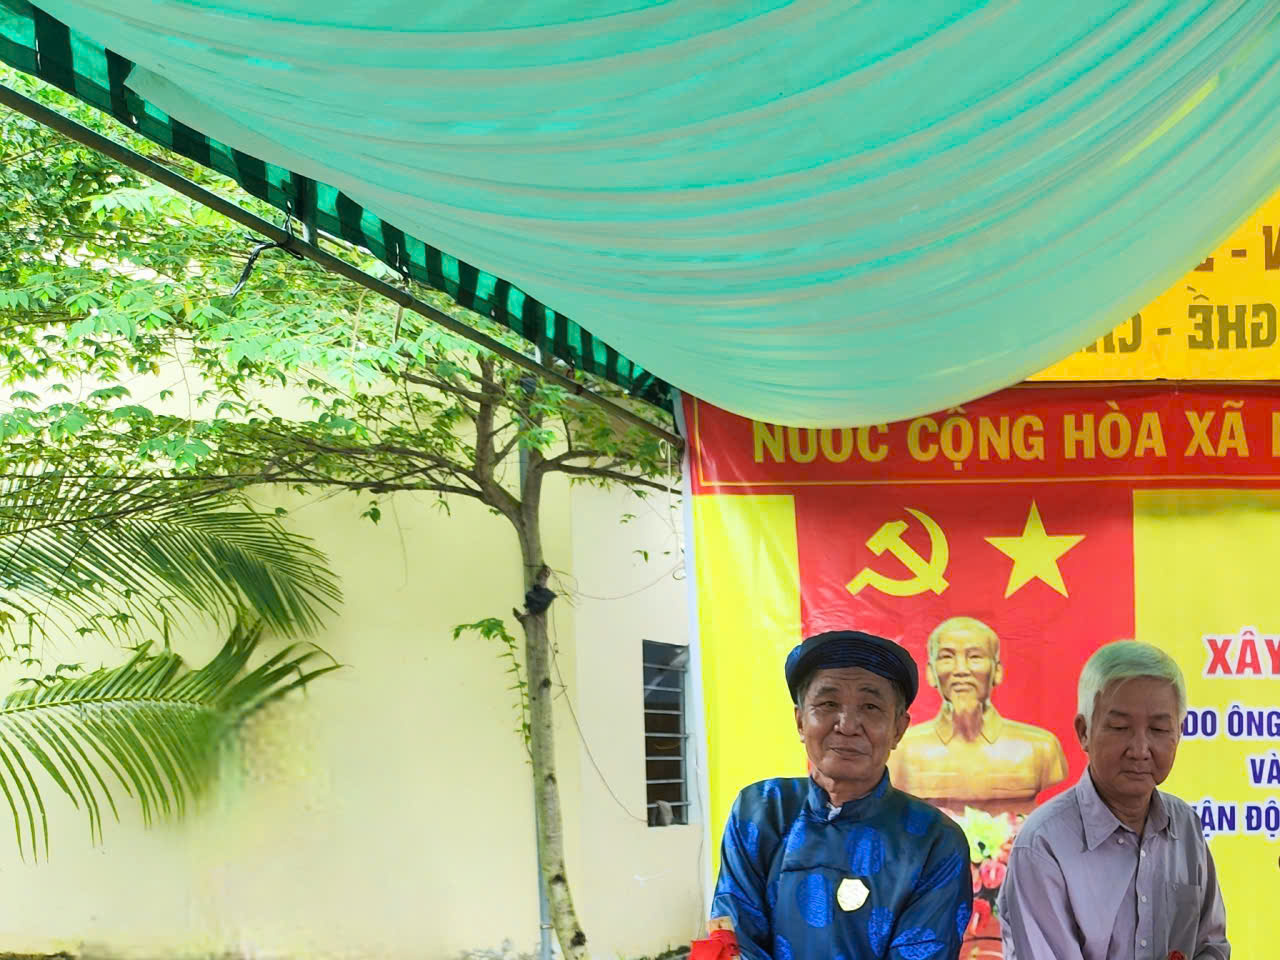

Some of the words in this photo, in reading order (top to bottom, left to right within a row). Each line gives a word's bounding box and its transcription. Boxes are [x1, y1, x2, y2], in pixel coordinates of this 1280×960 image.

[907, 406, 1046, 471] CỘNG
[1064, 402, 1166, 459] HÒA
[1184, 401, 1249, 458] XÃ
